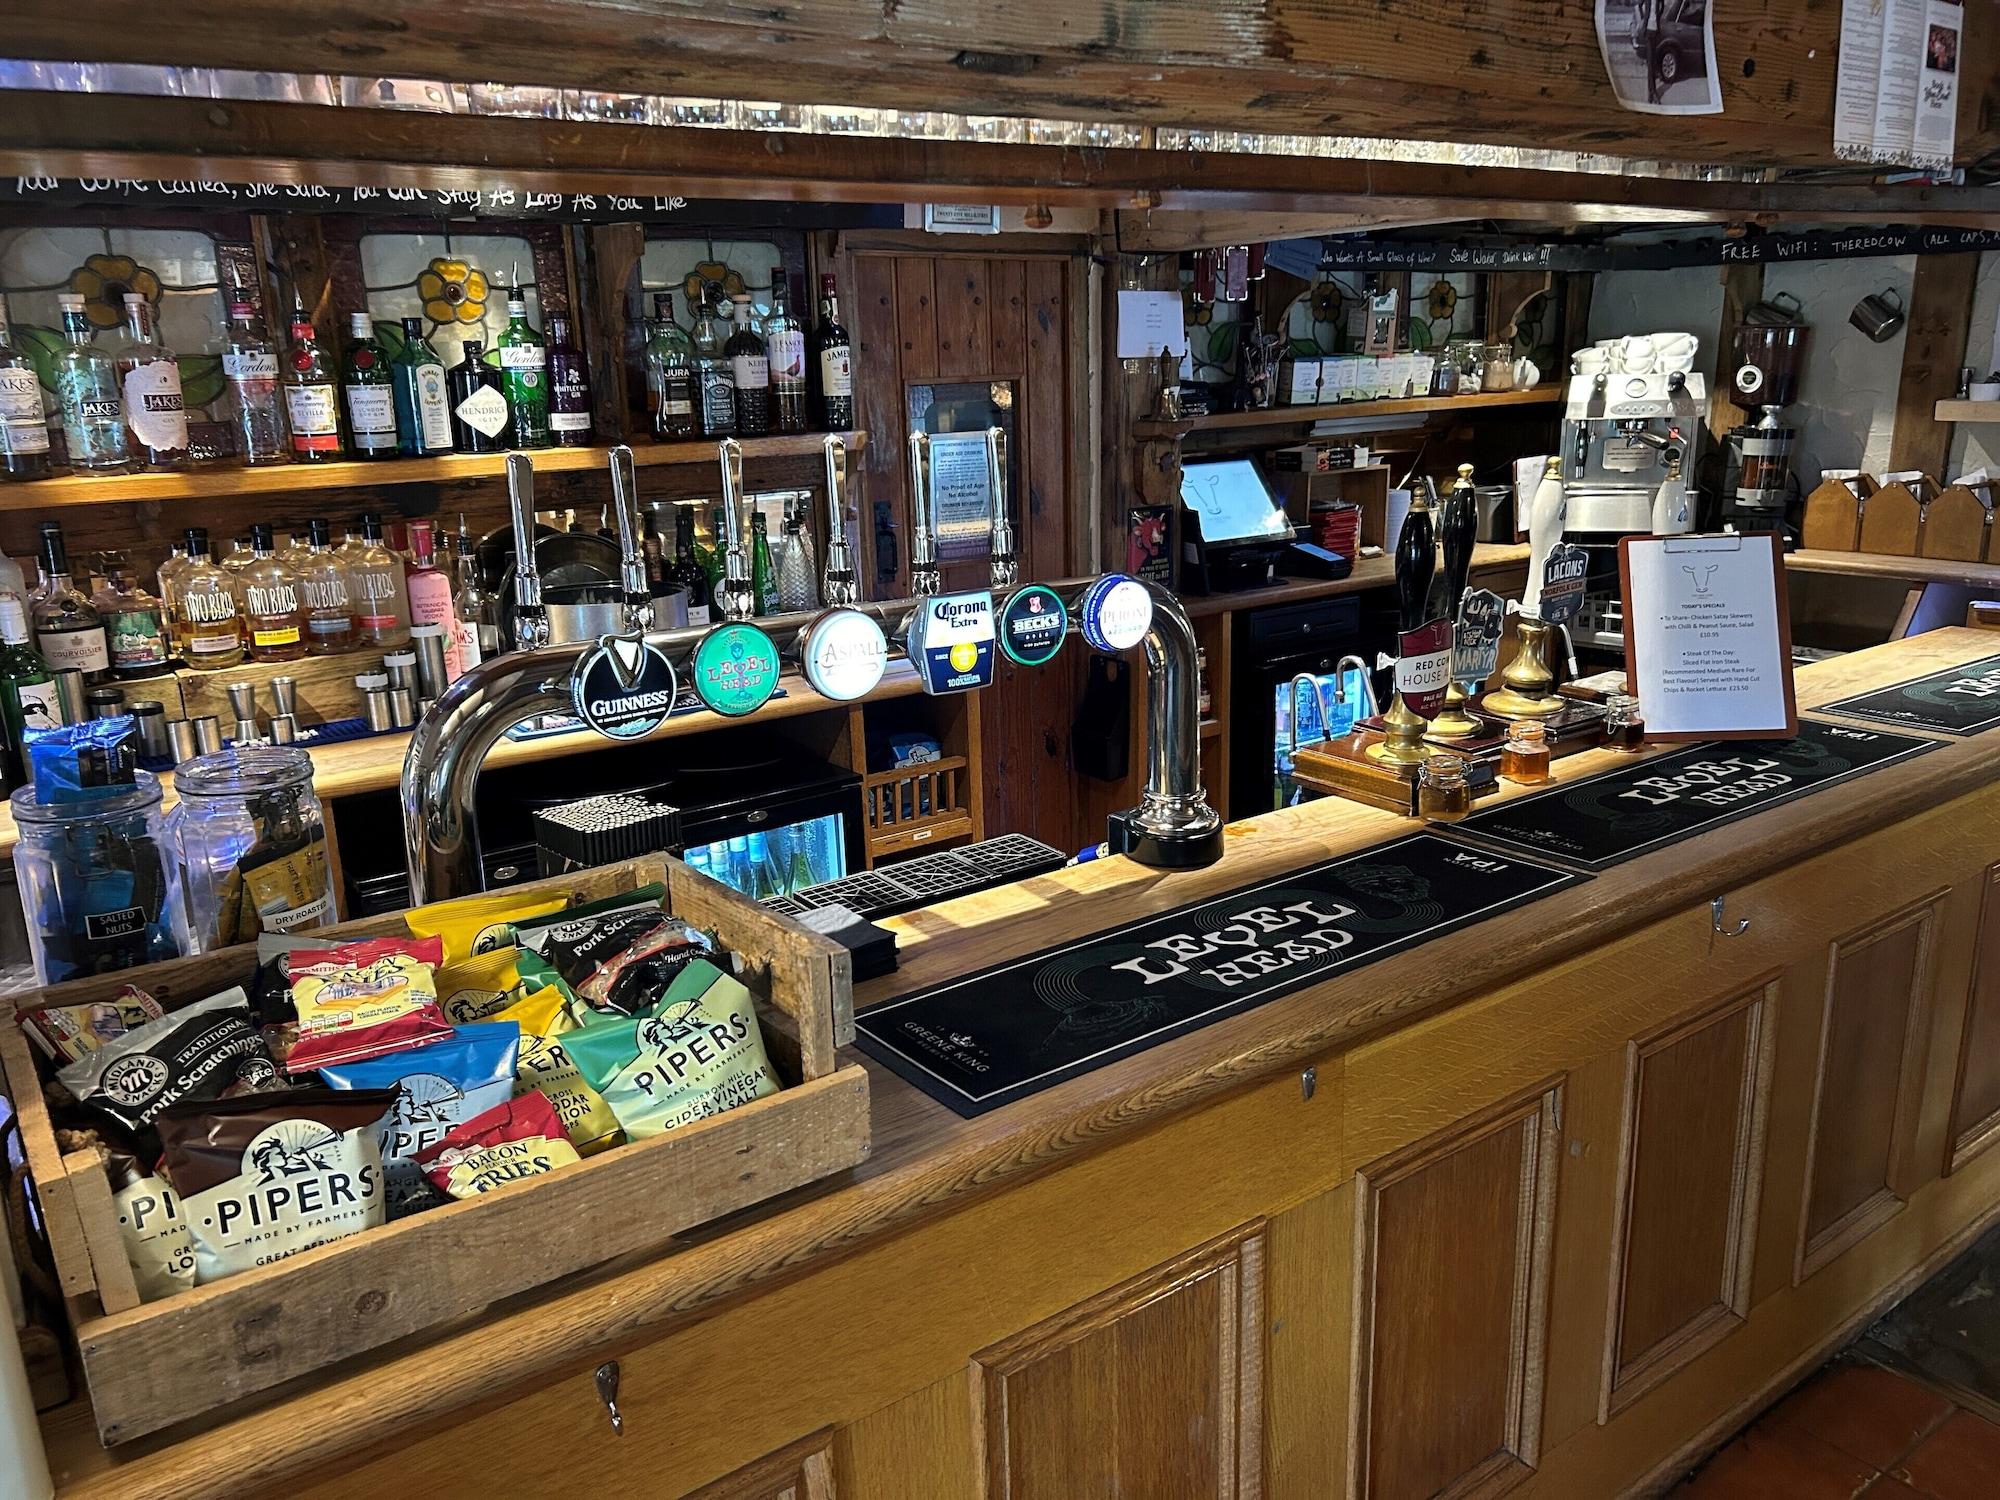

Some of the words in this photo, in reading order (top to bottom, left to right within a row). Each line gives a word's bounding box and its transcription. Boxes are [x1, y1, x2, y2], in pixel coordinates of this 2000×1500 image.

[525, 192, 562, 211] Long
[572, 193, 597, 212] As
[607, 194, 643, 211] You
[1721, 244, 1761, 260] FREE
[1832, 237, 1907, 253] THEREDCOW
[0, 377, 34, 393] AKES
[665, 368, 690, 378] JURA
[1548, 559, 1584, 583] LACONS
[185, 590, 208, 621] TWO
[209, 589, 235, 620] BIRDS
[246, 585, 269, 615] TWO
[270, 584, 298, 613] BIRDS
[935, 601, 988, 621] Corona
[951, 617, 978, 628] Extra
[53, 647, 102, 658] COURVOISIER
[1416, 660, 1433, 671] RED
[1454, 647, 1496, 673] MARTYR
[707, 656, 772, 682] LEVEL
[1403, 671, 1441, 686] HOUSE
[591, 690, 669, 716] GUINNESS
[1619, 757, 1780, 805] LEVEL
[1691, 772, 1792, 806] HEAD
[1454, 853, 1509, 871] IPA
[100, 910, 135, 925] SALTED
[275, 913, 294, 925] DRY
[296, 901, 327, 920] ROASTED
[105, 922, 132, 934] NUTS
[573, 931, 606, 957] Pork
[1111, 901, 1356, 985] LEVEL
[1200, 928, 1354, 986] HEAD
[634, 1012, 749, 1096] PIPERS
[905, 1021, 956, 1051] GREENE
[954, 1051, 990, 1072] KING
[107, 1059, 155, 1091] MIDLAND
[122, 1072, 165, 1102] SNACKS
[140, 1086, 183, 1125] Pork
[178, 1034, 264, 1091] Scratchings
[667, 1082, 692, 1100] MADE
[695, 1073, 705, 1082] BY
[710, 1048, 746, 1073] FARMERS
[665, 1101, 712, 1130] CIDER
[713, 1065, 768, 1105] VINEGAR
[687, 1081, 726, 1108] BURROW
[728, 1069, 746, 1083] HILL
[729, 1085, 758, 1109] SALT
[466, 1143, 528, 1171] BACON
[485, 1157, 516, 1170] FLAVOUR
[469, 1156, 553, 1193] FRIES
[217, 1168, 374, 1235] PIPERS
[160, 1225, 187, 1238] MAD
[244, 1229, 280, 1246] MADE
[286, 1223, 300, 1233] BY
[308, 1208, 365, 1228] FARMERS
[256, 1248, 298, 1266] GREAT
